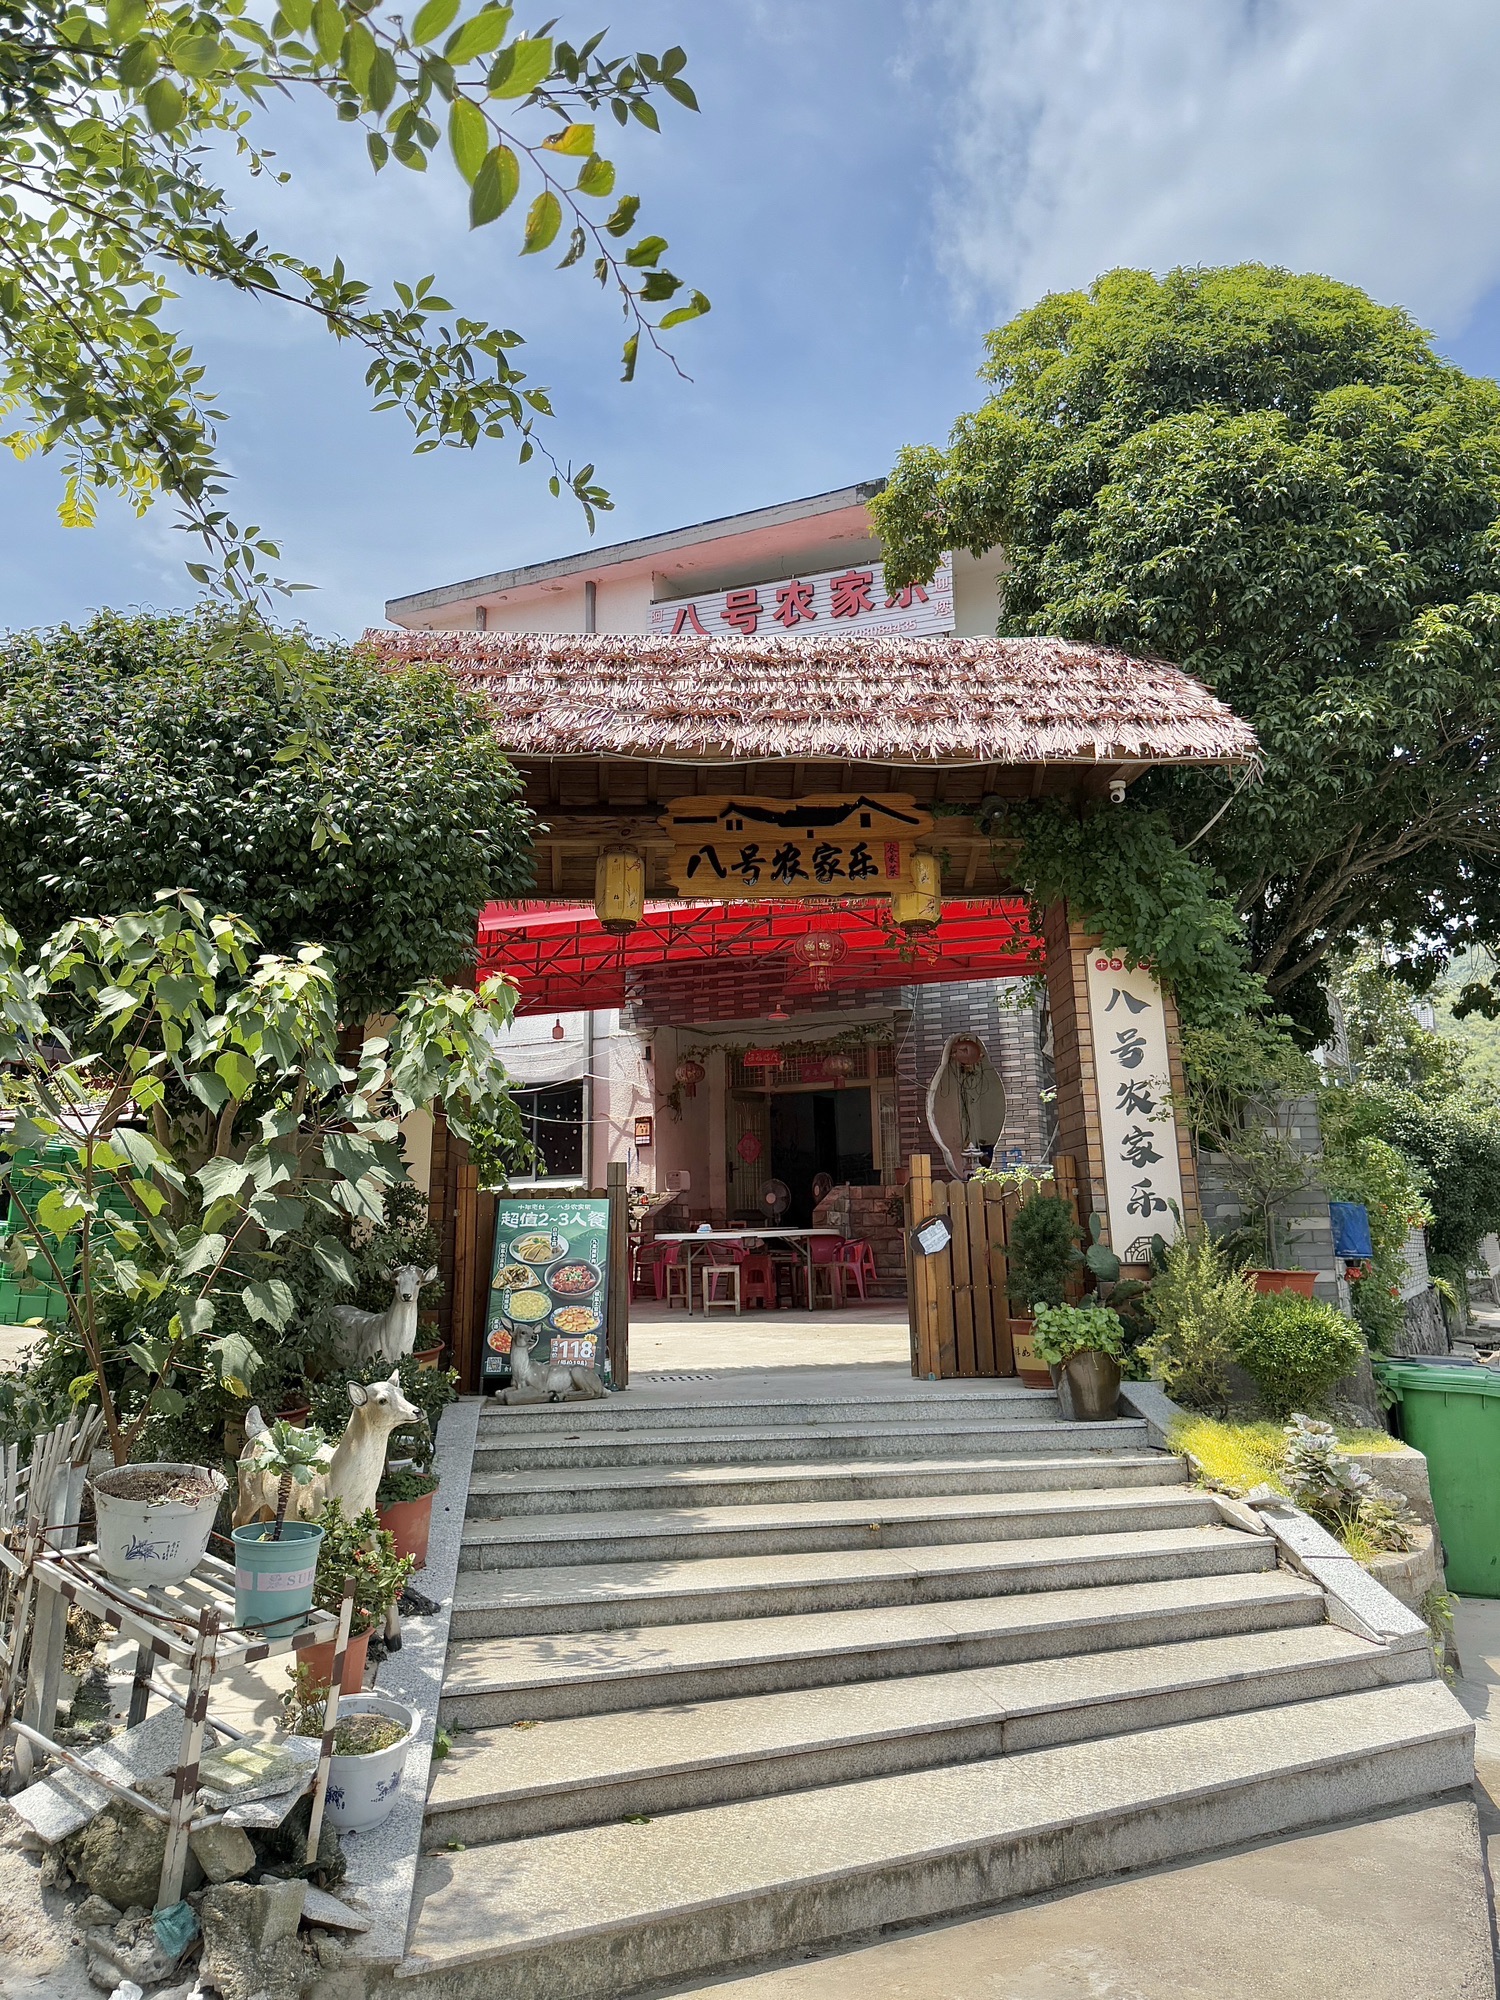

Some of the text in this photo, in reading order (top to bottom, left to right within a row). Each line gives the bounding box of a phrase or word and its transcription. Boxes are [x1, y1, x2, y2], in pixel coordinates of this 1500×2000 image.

[687, 842, 879, 886] 八号农家乐
[1104, 987, 1168, 1218] 八号农家乐
[501, 1211, 606, 1228] 超值2~3人餐
